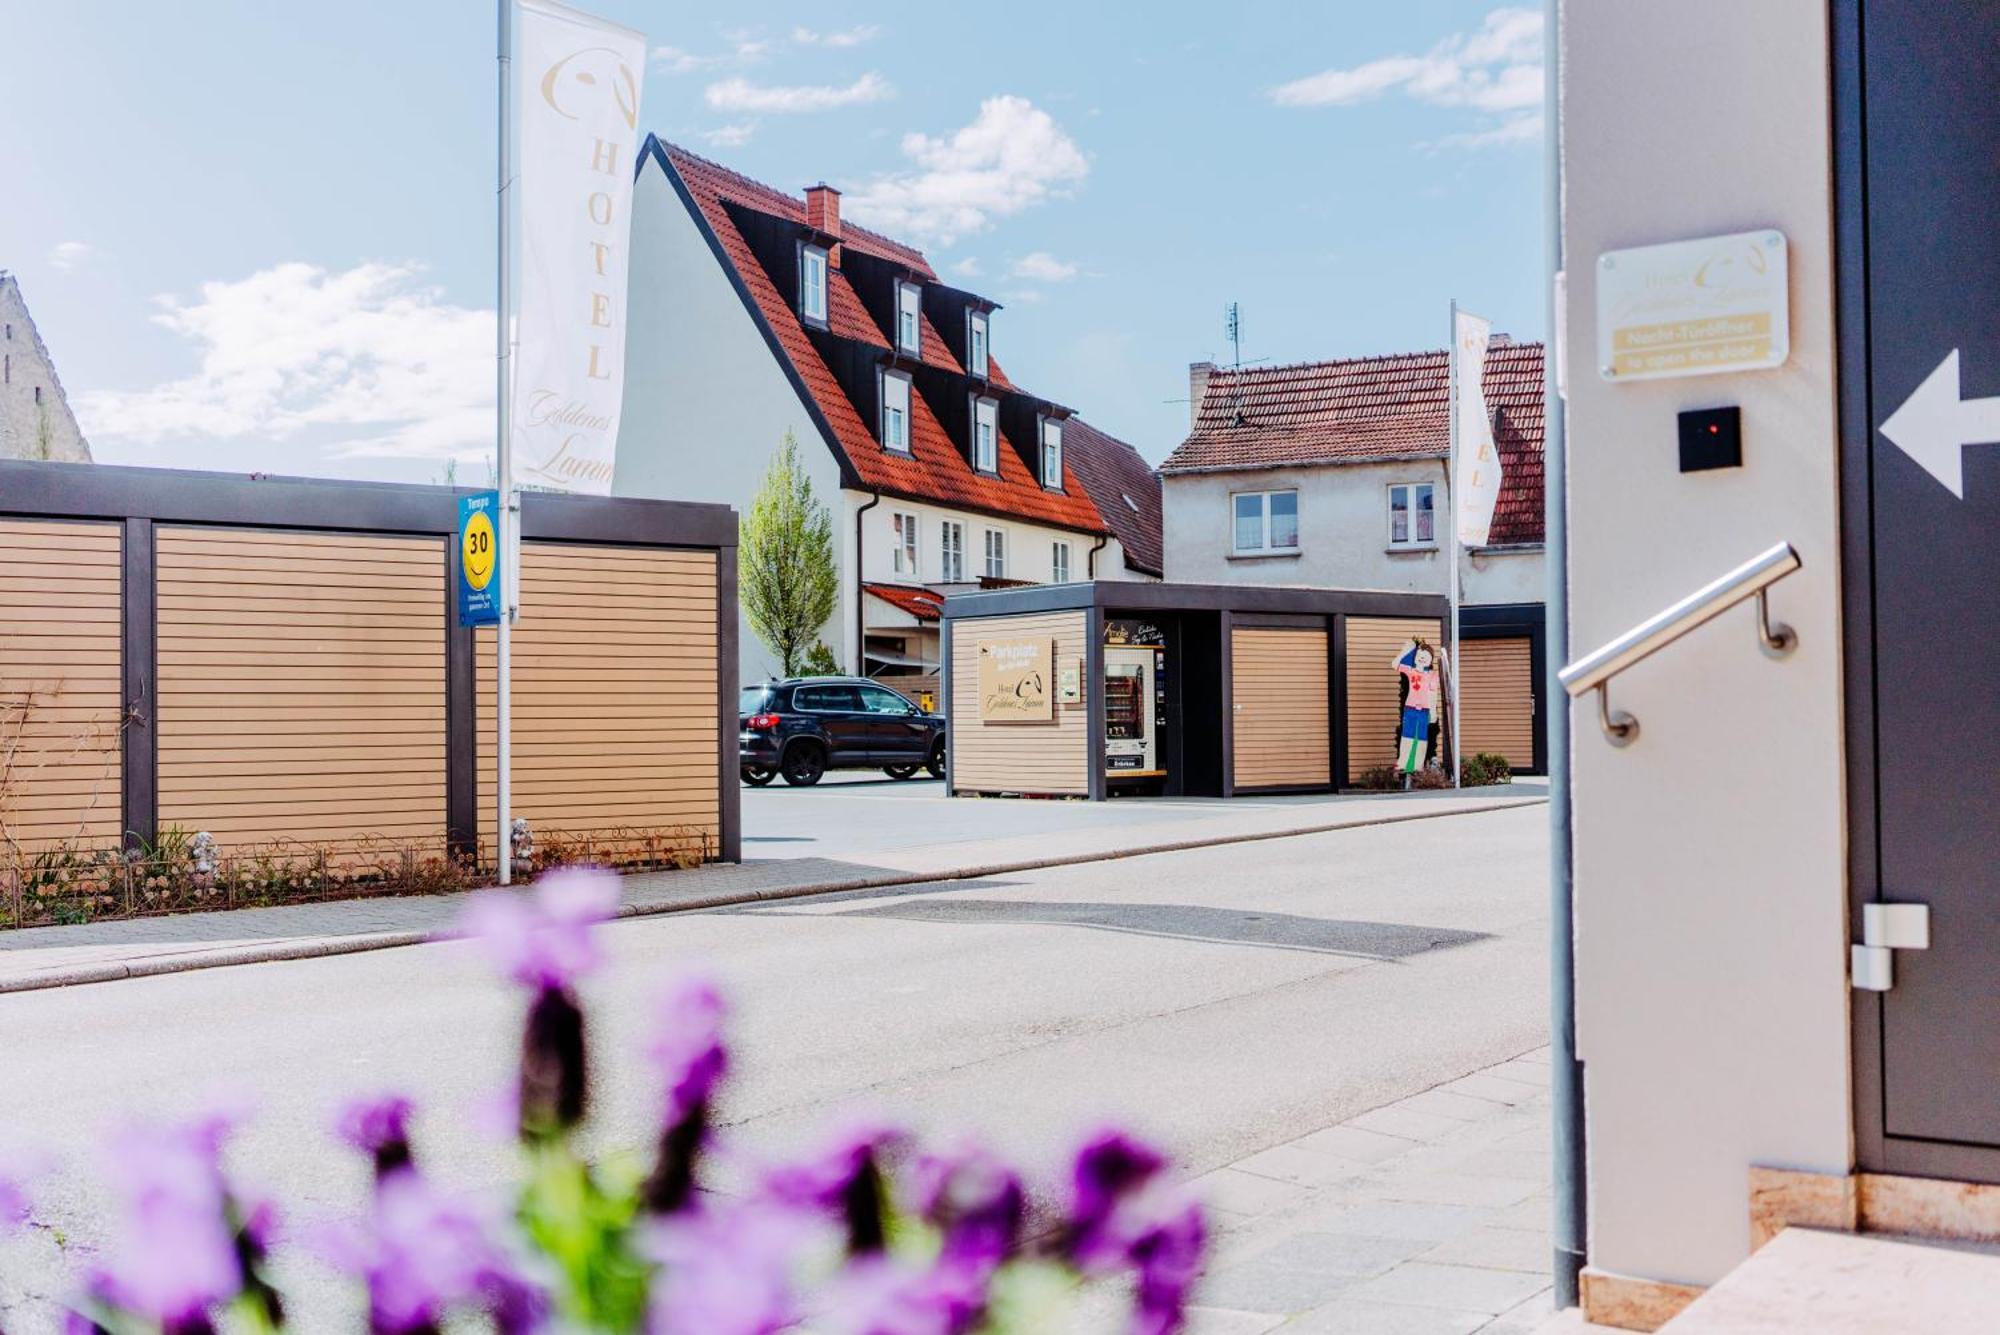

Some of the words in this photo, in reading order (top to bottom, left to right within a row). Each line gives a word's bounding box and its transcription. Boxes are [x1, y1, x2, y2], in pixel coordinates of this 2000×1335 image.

[587, 137, 619, 380] HOTEL
[467, 497, 489, 512] Tempo
[470, 531, 488, 555] 30
